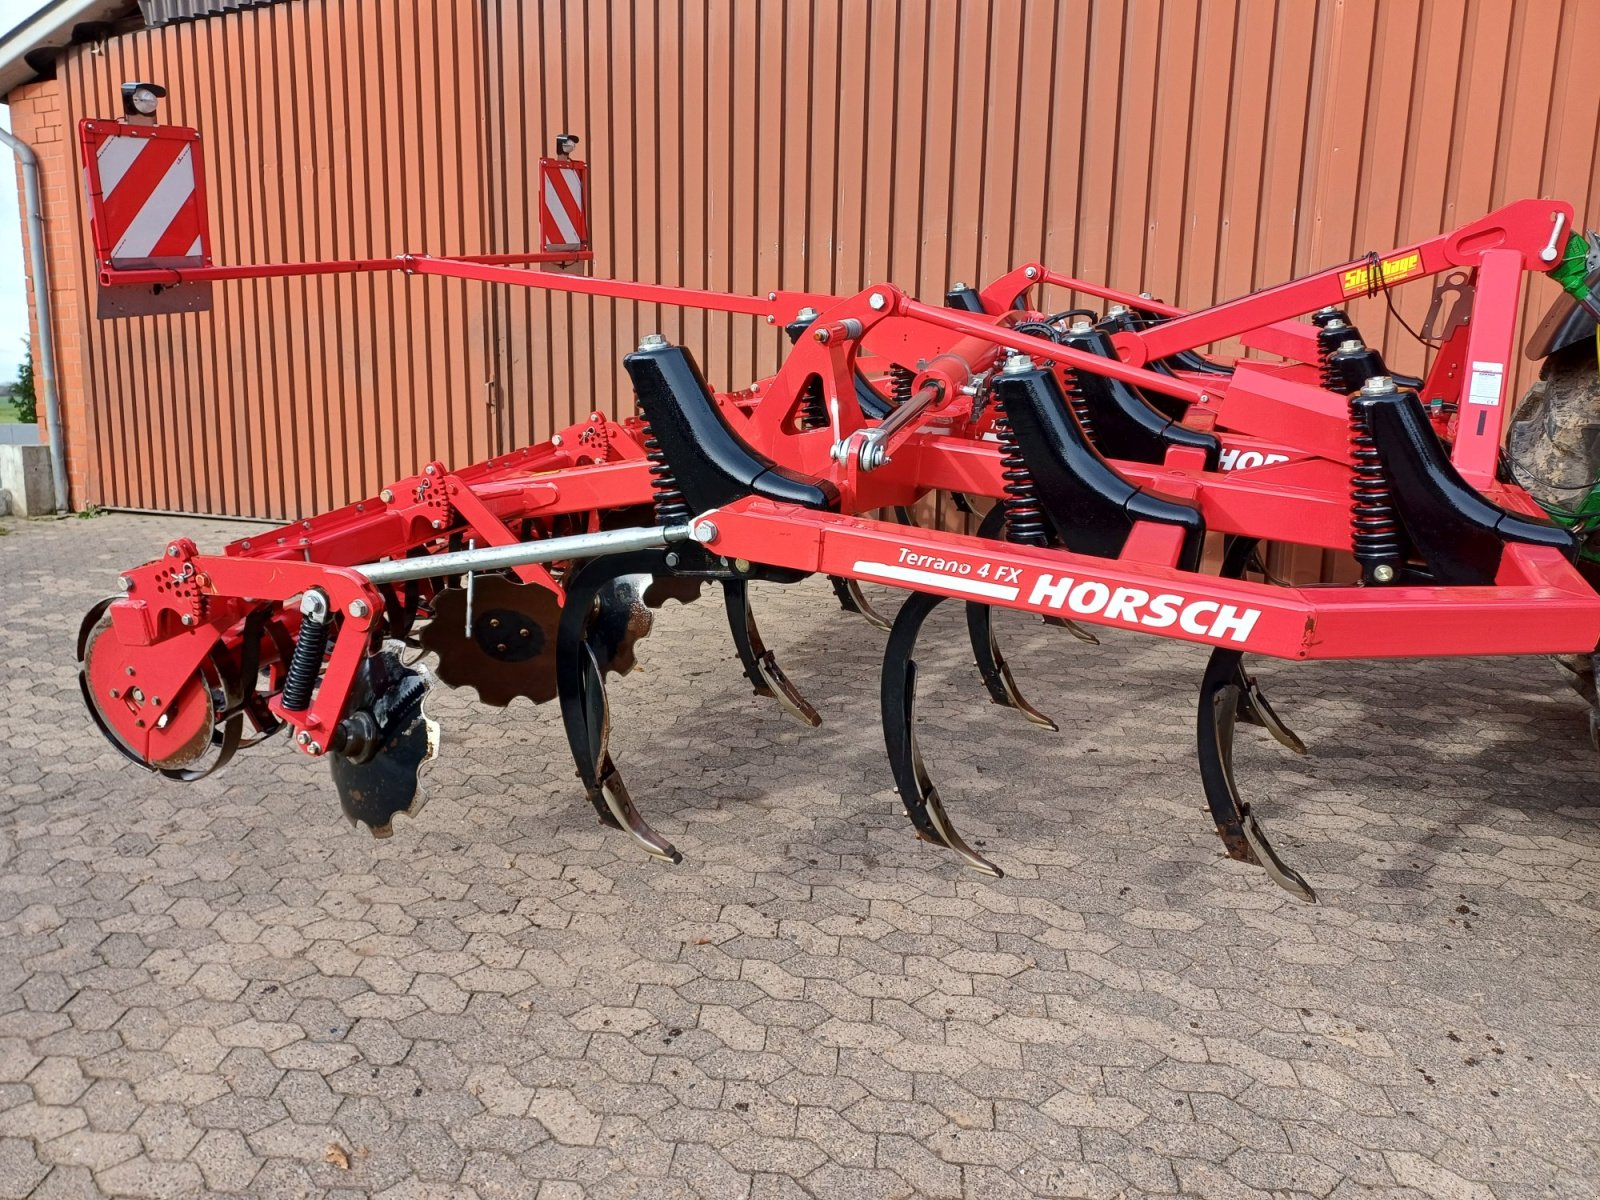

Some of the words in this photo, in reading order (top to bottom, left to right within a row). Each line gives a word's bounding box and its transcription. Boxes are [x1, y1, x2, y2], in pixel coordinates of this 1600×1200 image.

[897, 547, 972, 575] Terrano
[977, 562, 990, 579] 4
[994, 565, 1024, 584] FX
[1028, 573, 1262, 643] HORSCH
